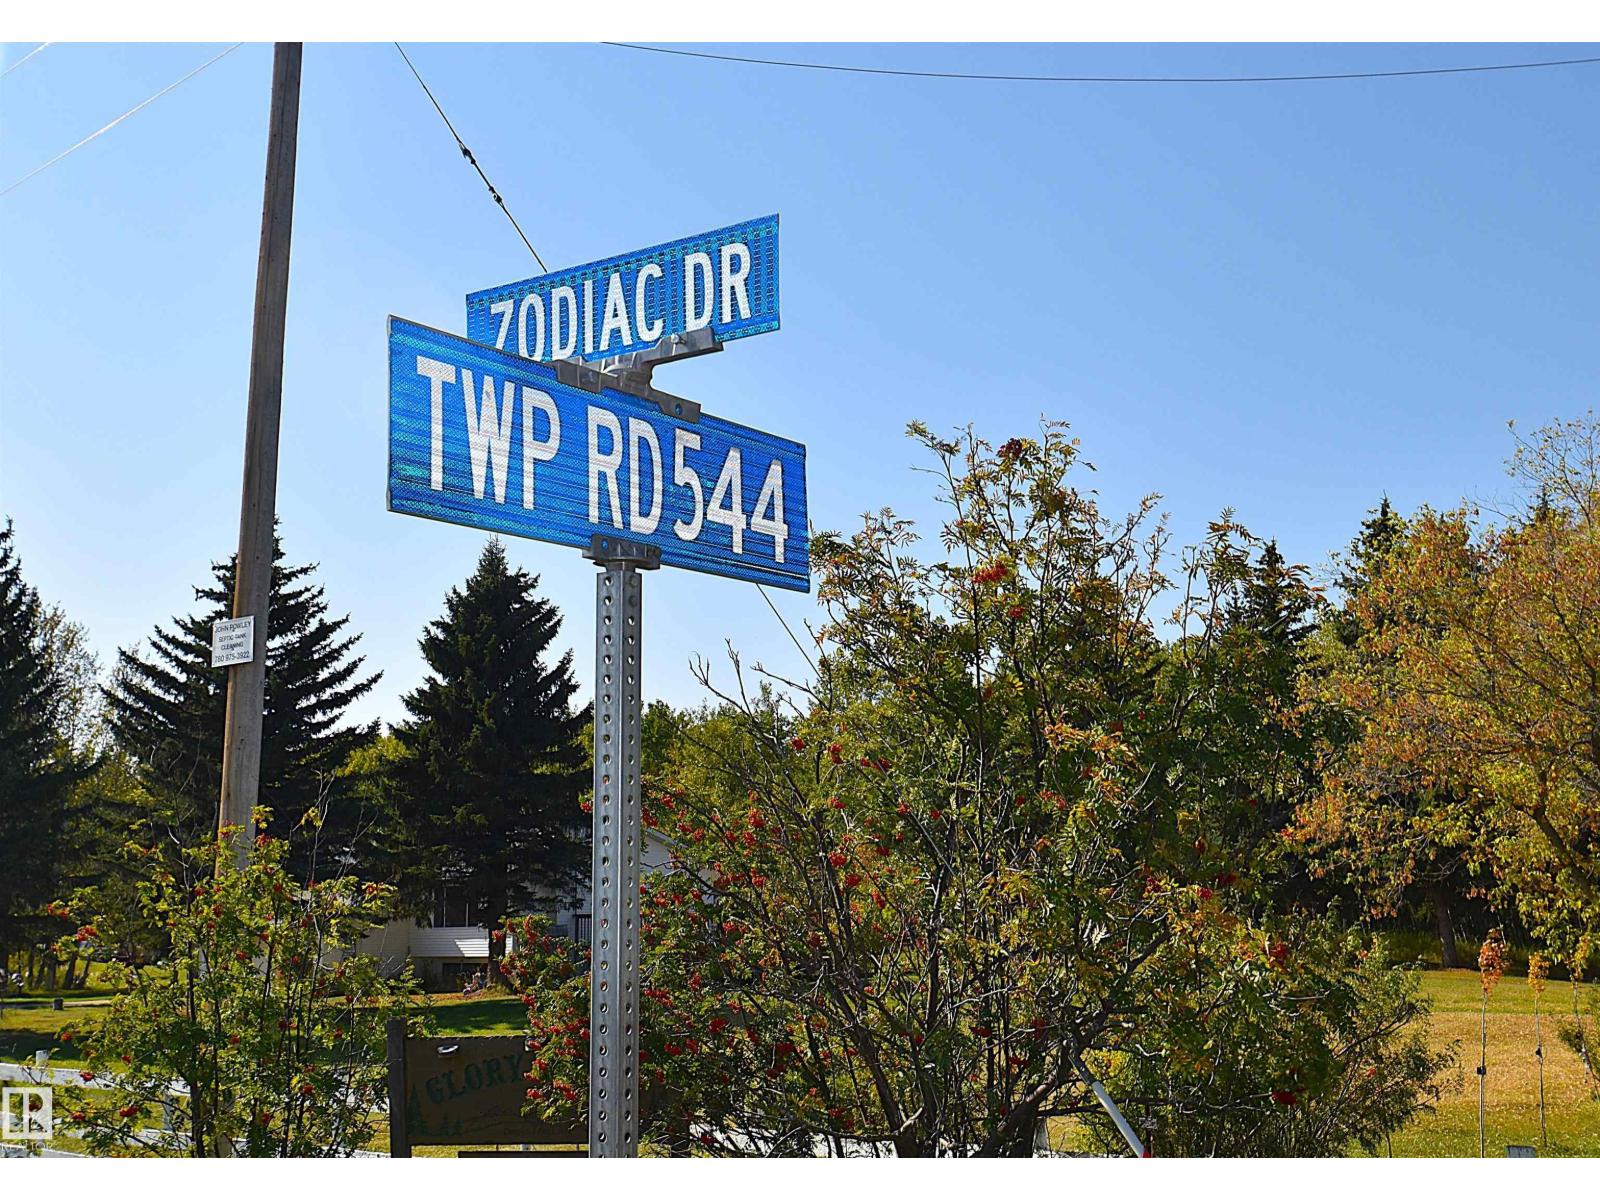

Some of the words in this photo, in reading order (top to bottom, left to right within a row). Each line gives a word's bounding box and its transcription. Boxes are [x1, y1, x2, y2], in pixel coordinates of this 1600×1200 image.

[490, 264, 664, 362] ZODIAC
[684, 242, 751, 332] DR
[416, 355, 561, 510] TWP
[587, 405, 662, 535] RD
[673, 429, 788, 563] 544
[215, 625, 229, 633] JOHN
[221, 642, 244, 650] CLEANING
[425, 1054, 524, 1104] GLORY
